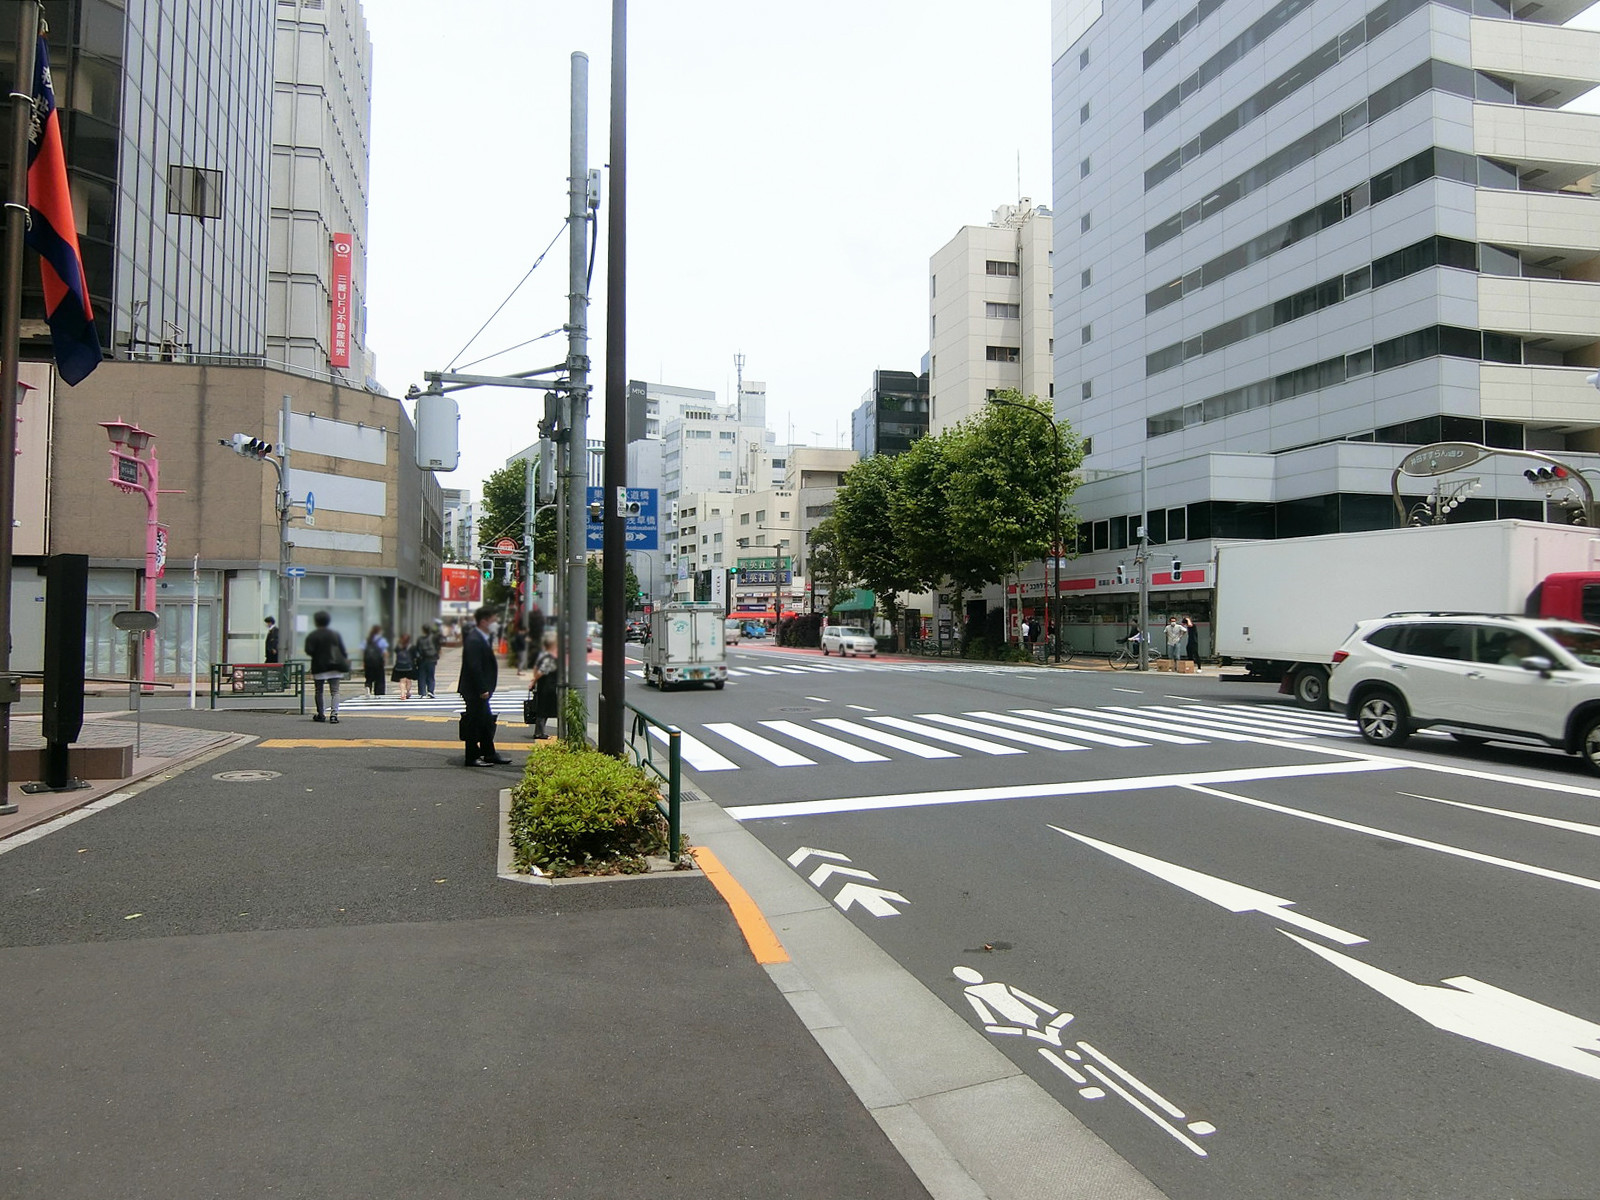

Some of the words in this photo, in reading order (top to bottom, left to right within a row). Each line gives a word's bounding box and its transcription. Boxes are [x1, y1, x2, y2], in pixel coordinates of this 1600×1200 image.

[335, 274, 347, 357] 三菱UFJ不動産販売
